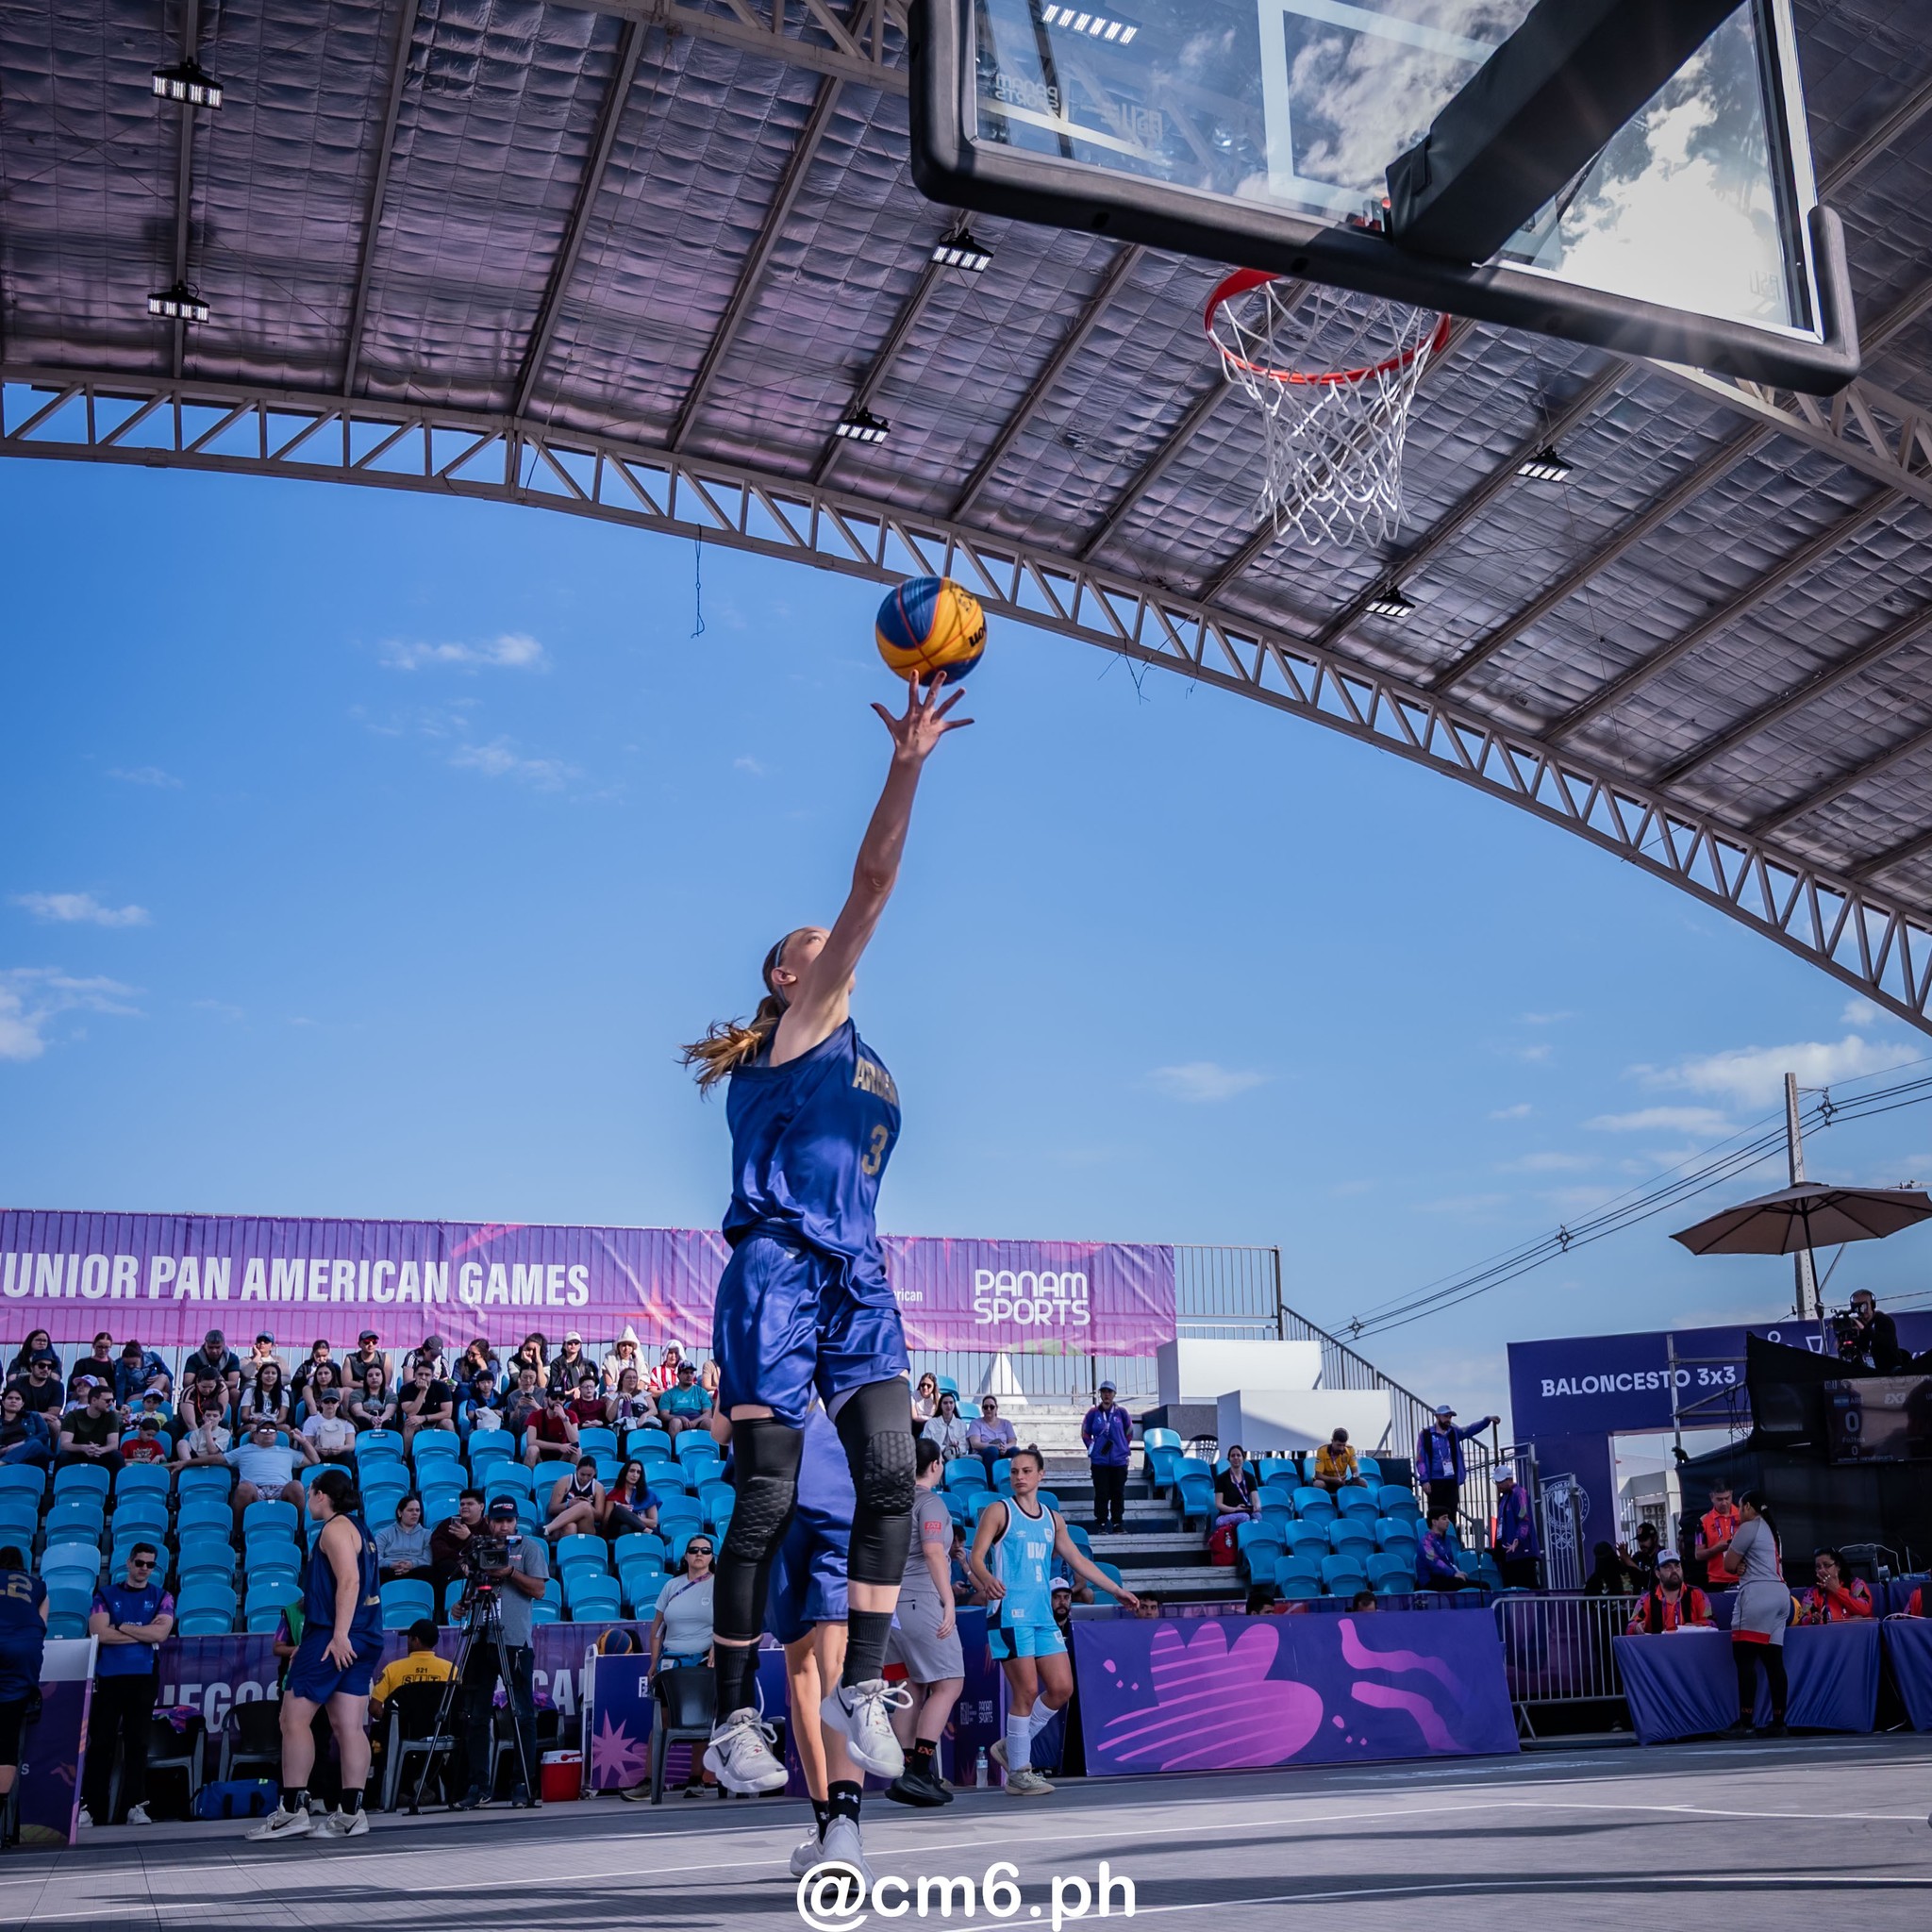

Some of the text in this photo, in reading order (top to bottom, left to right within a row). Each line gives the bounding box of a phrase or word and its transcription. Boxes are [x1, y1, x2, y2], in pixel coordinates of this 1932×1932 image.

[861, 1124, 889, 1175] 3
[0, 1252, 590, 1307] UNIOR PAN AMERICAN GAMES
[974, 1269, 1088, 1298] PANAM
[974, 1297, 1091, 1326] SPORTS
[1541, 1365, 1736, 1398] BALONCESTO 3x3
[1844, 1410, 1859, 1432] 0
[1851, 1445, 1858, 1456] 0
